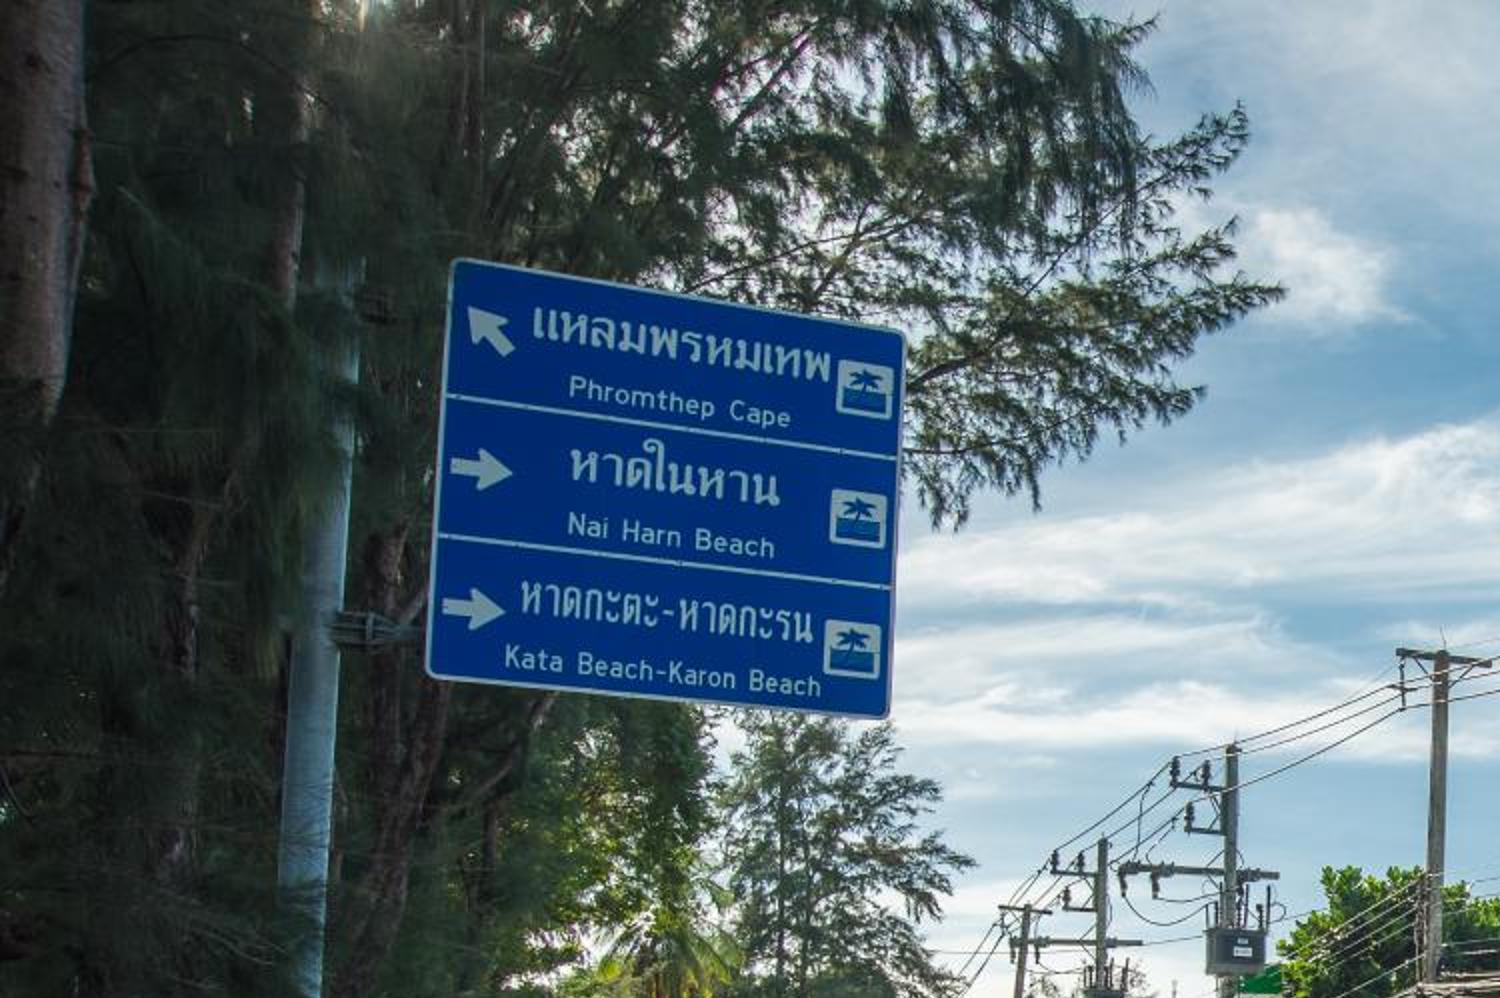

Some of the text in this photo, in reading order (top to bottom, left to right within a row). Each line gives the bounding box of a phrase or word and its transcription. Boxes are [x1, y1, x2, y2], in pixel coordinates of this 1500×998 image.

[532, 306, 831, 383] แหลมพรหมเทพ
[568, 375, 792, 430] Phromthep Cape
[570, 437, 781, 507] หาดในหาน
[567, 511, 775, 560] Nai Harn Beach
[520, 579, 814, 644] หาดกะตะ-หาดกะรน
[504, 643, 822, 698] Kata Beach-Karon Beach
